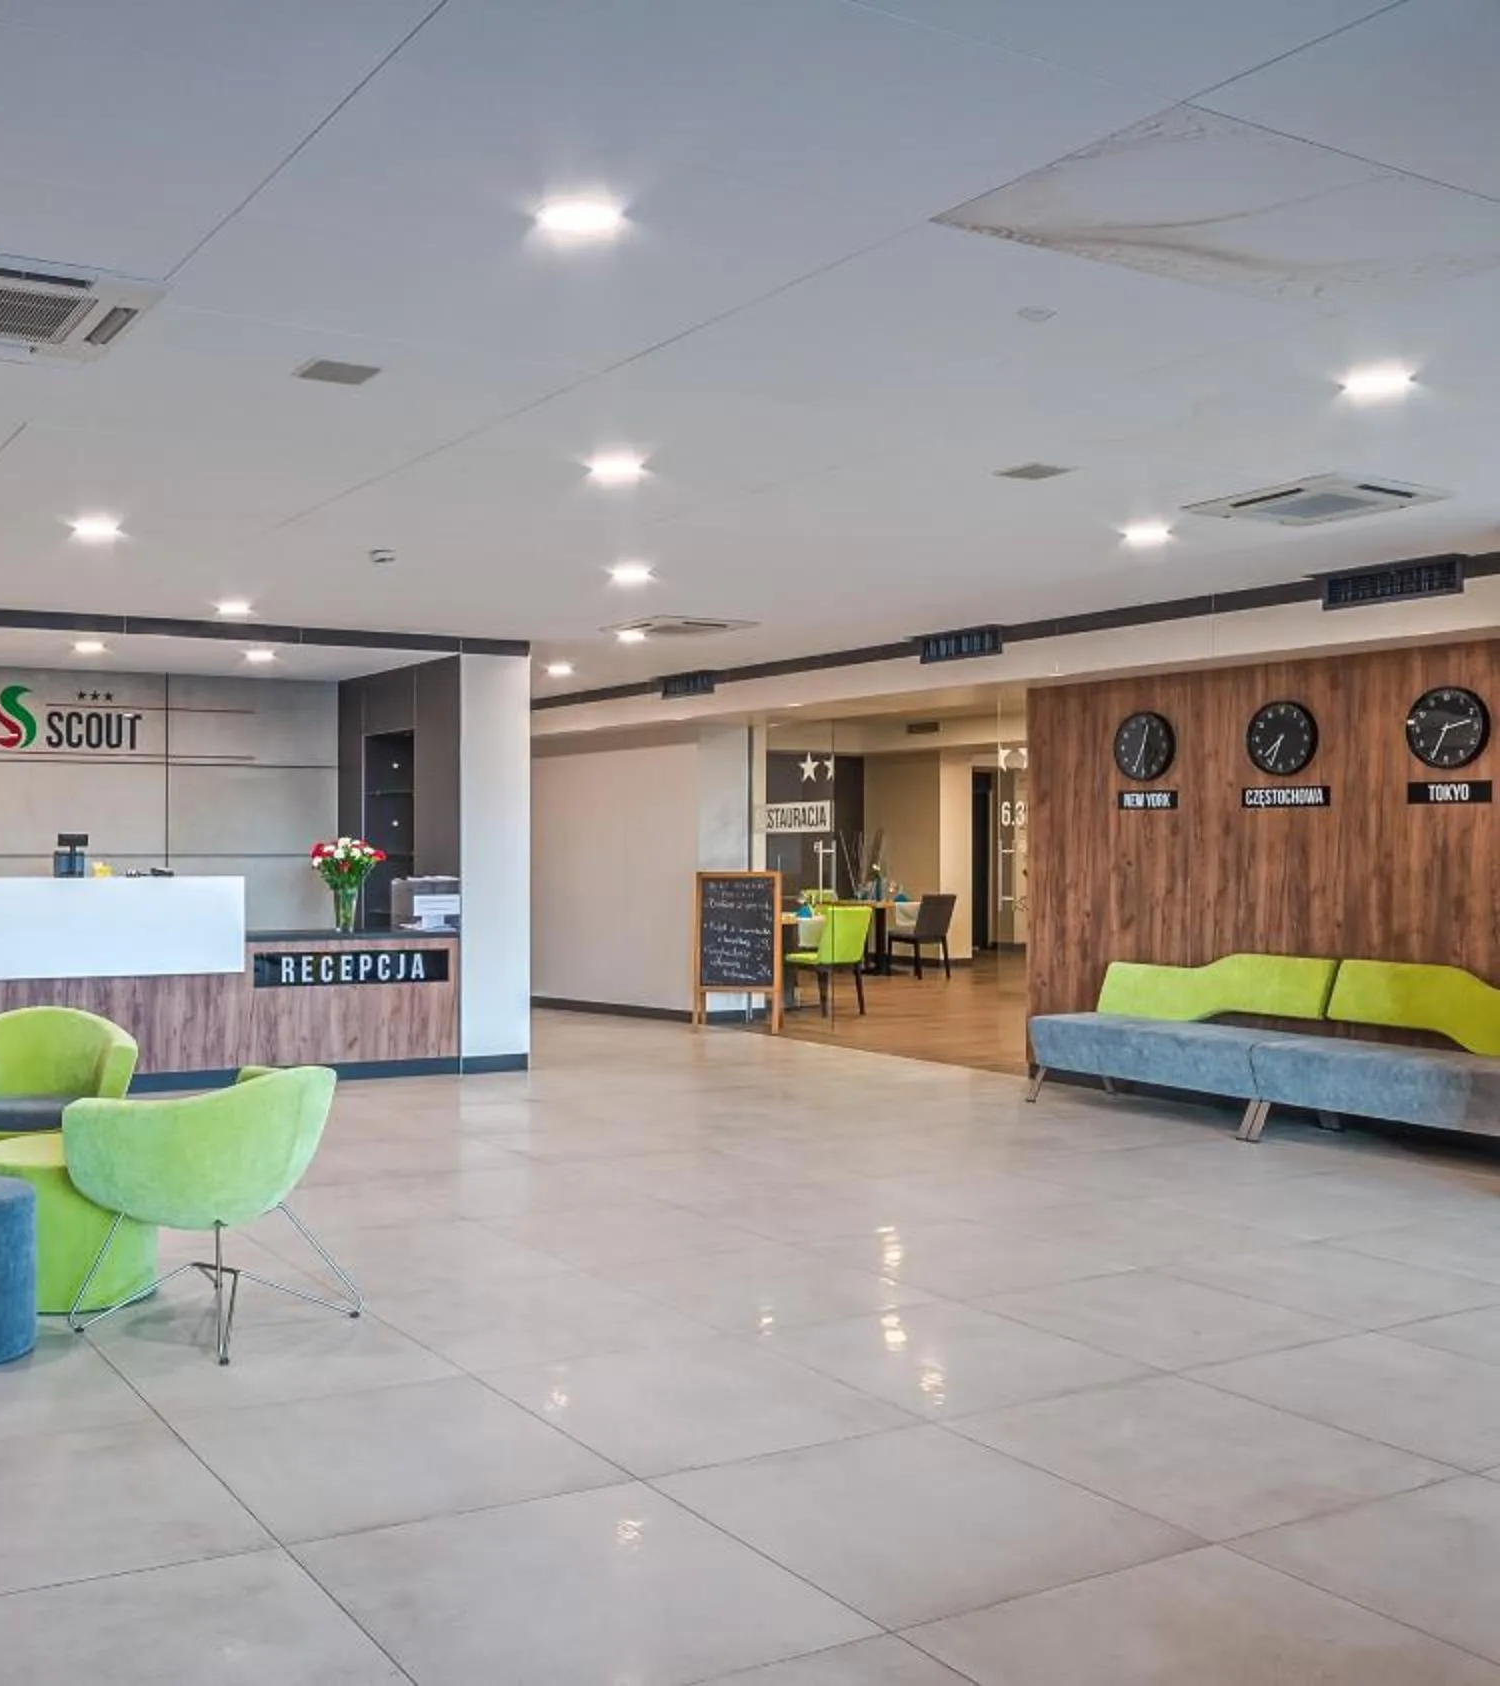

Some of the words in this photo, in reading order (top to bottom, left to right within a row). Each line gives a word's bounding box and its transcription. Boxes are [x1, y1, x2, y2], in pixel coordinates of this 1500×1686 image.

[46, 711, 142, 750] SCOUT
[1123, 793, 1144, 808] NEW
[1145, 792, 1171, 808] YORK
[1428, 783, 1469, 801] TOKYO
[1002, 801, 1028, 827] 6.3
[281, 953, 425, 983] RECEPCJA
